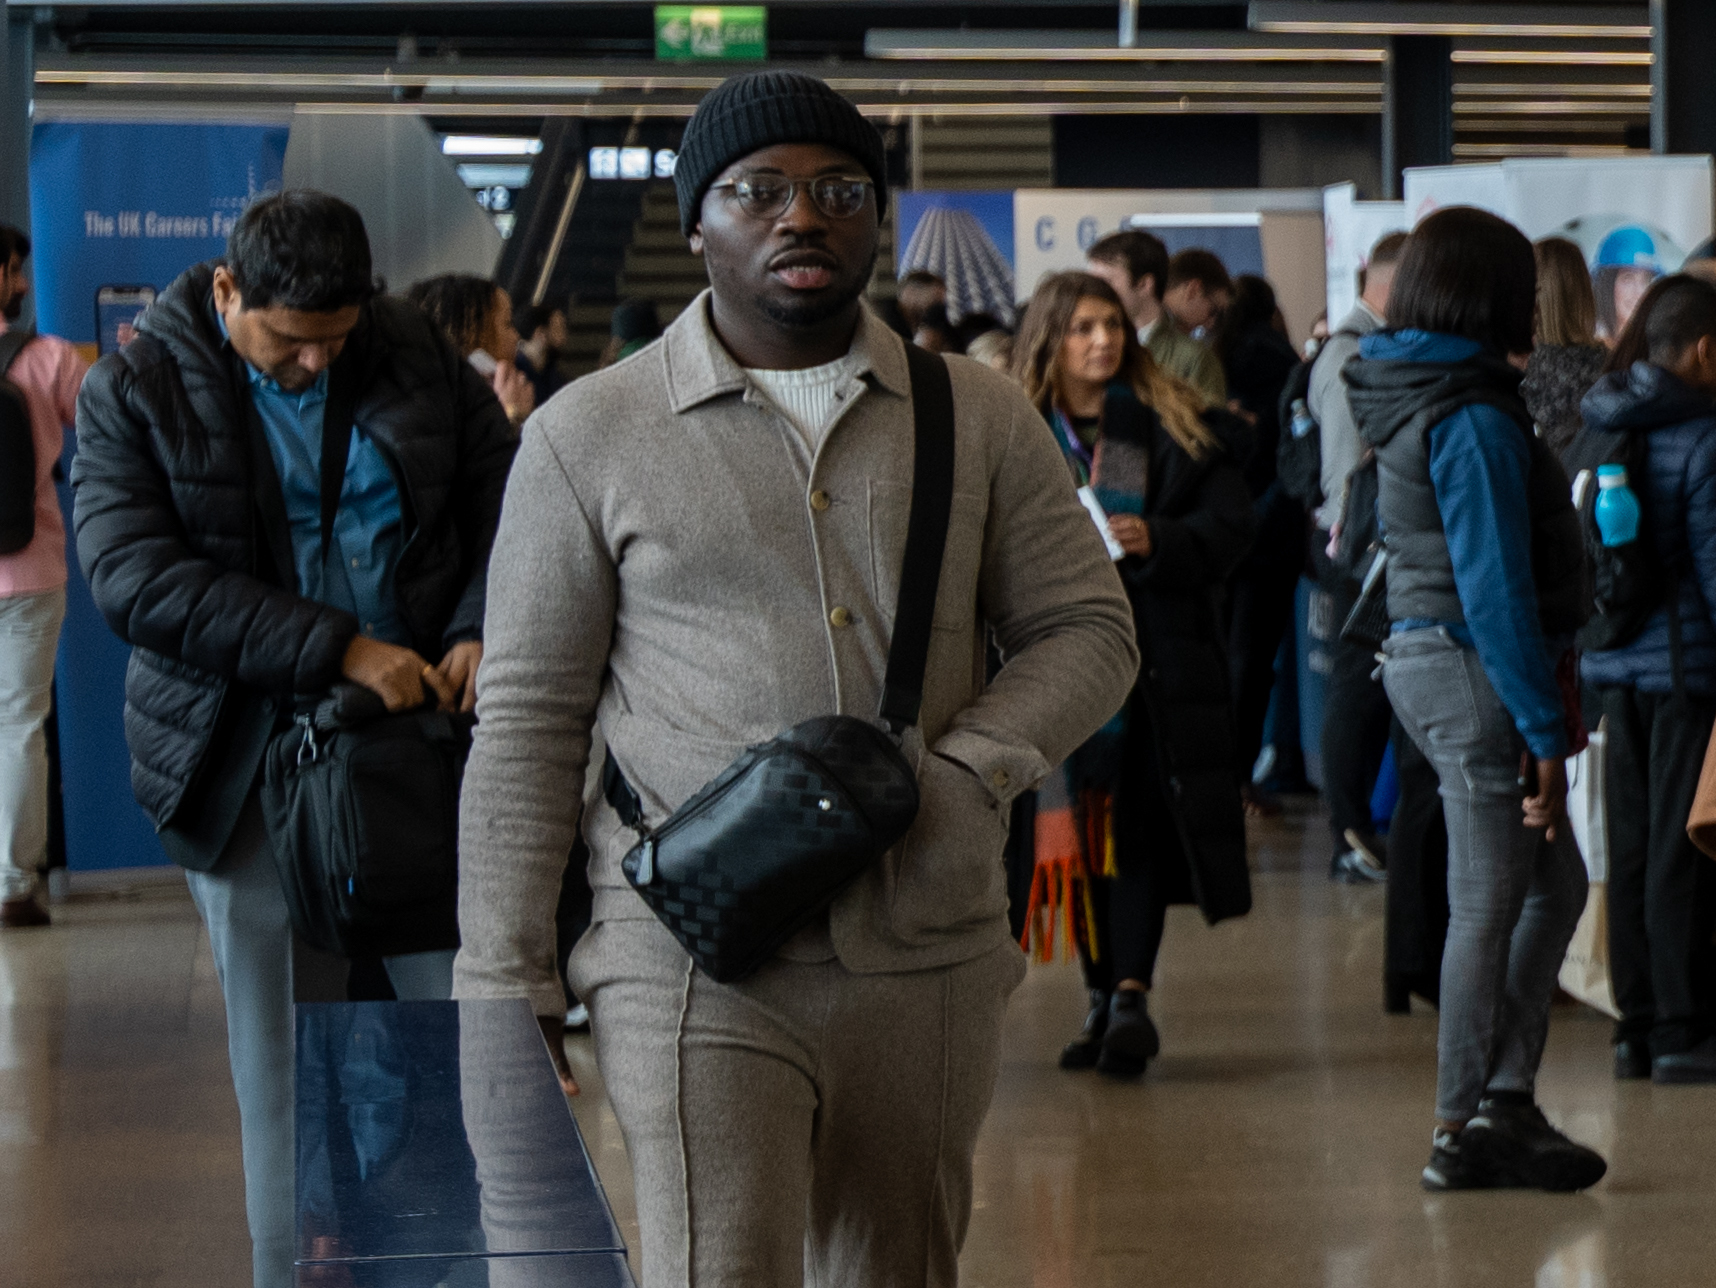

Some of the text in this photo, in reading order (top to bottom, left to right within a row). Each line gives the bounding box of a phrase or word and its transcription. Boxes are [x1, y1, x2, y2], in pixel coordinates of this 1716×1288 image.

[84, 210, 116, 238] The
[118, 211, 141, 238] UK
[144, 211, 208, 239] Careers
